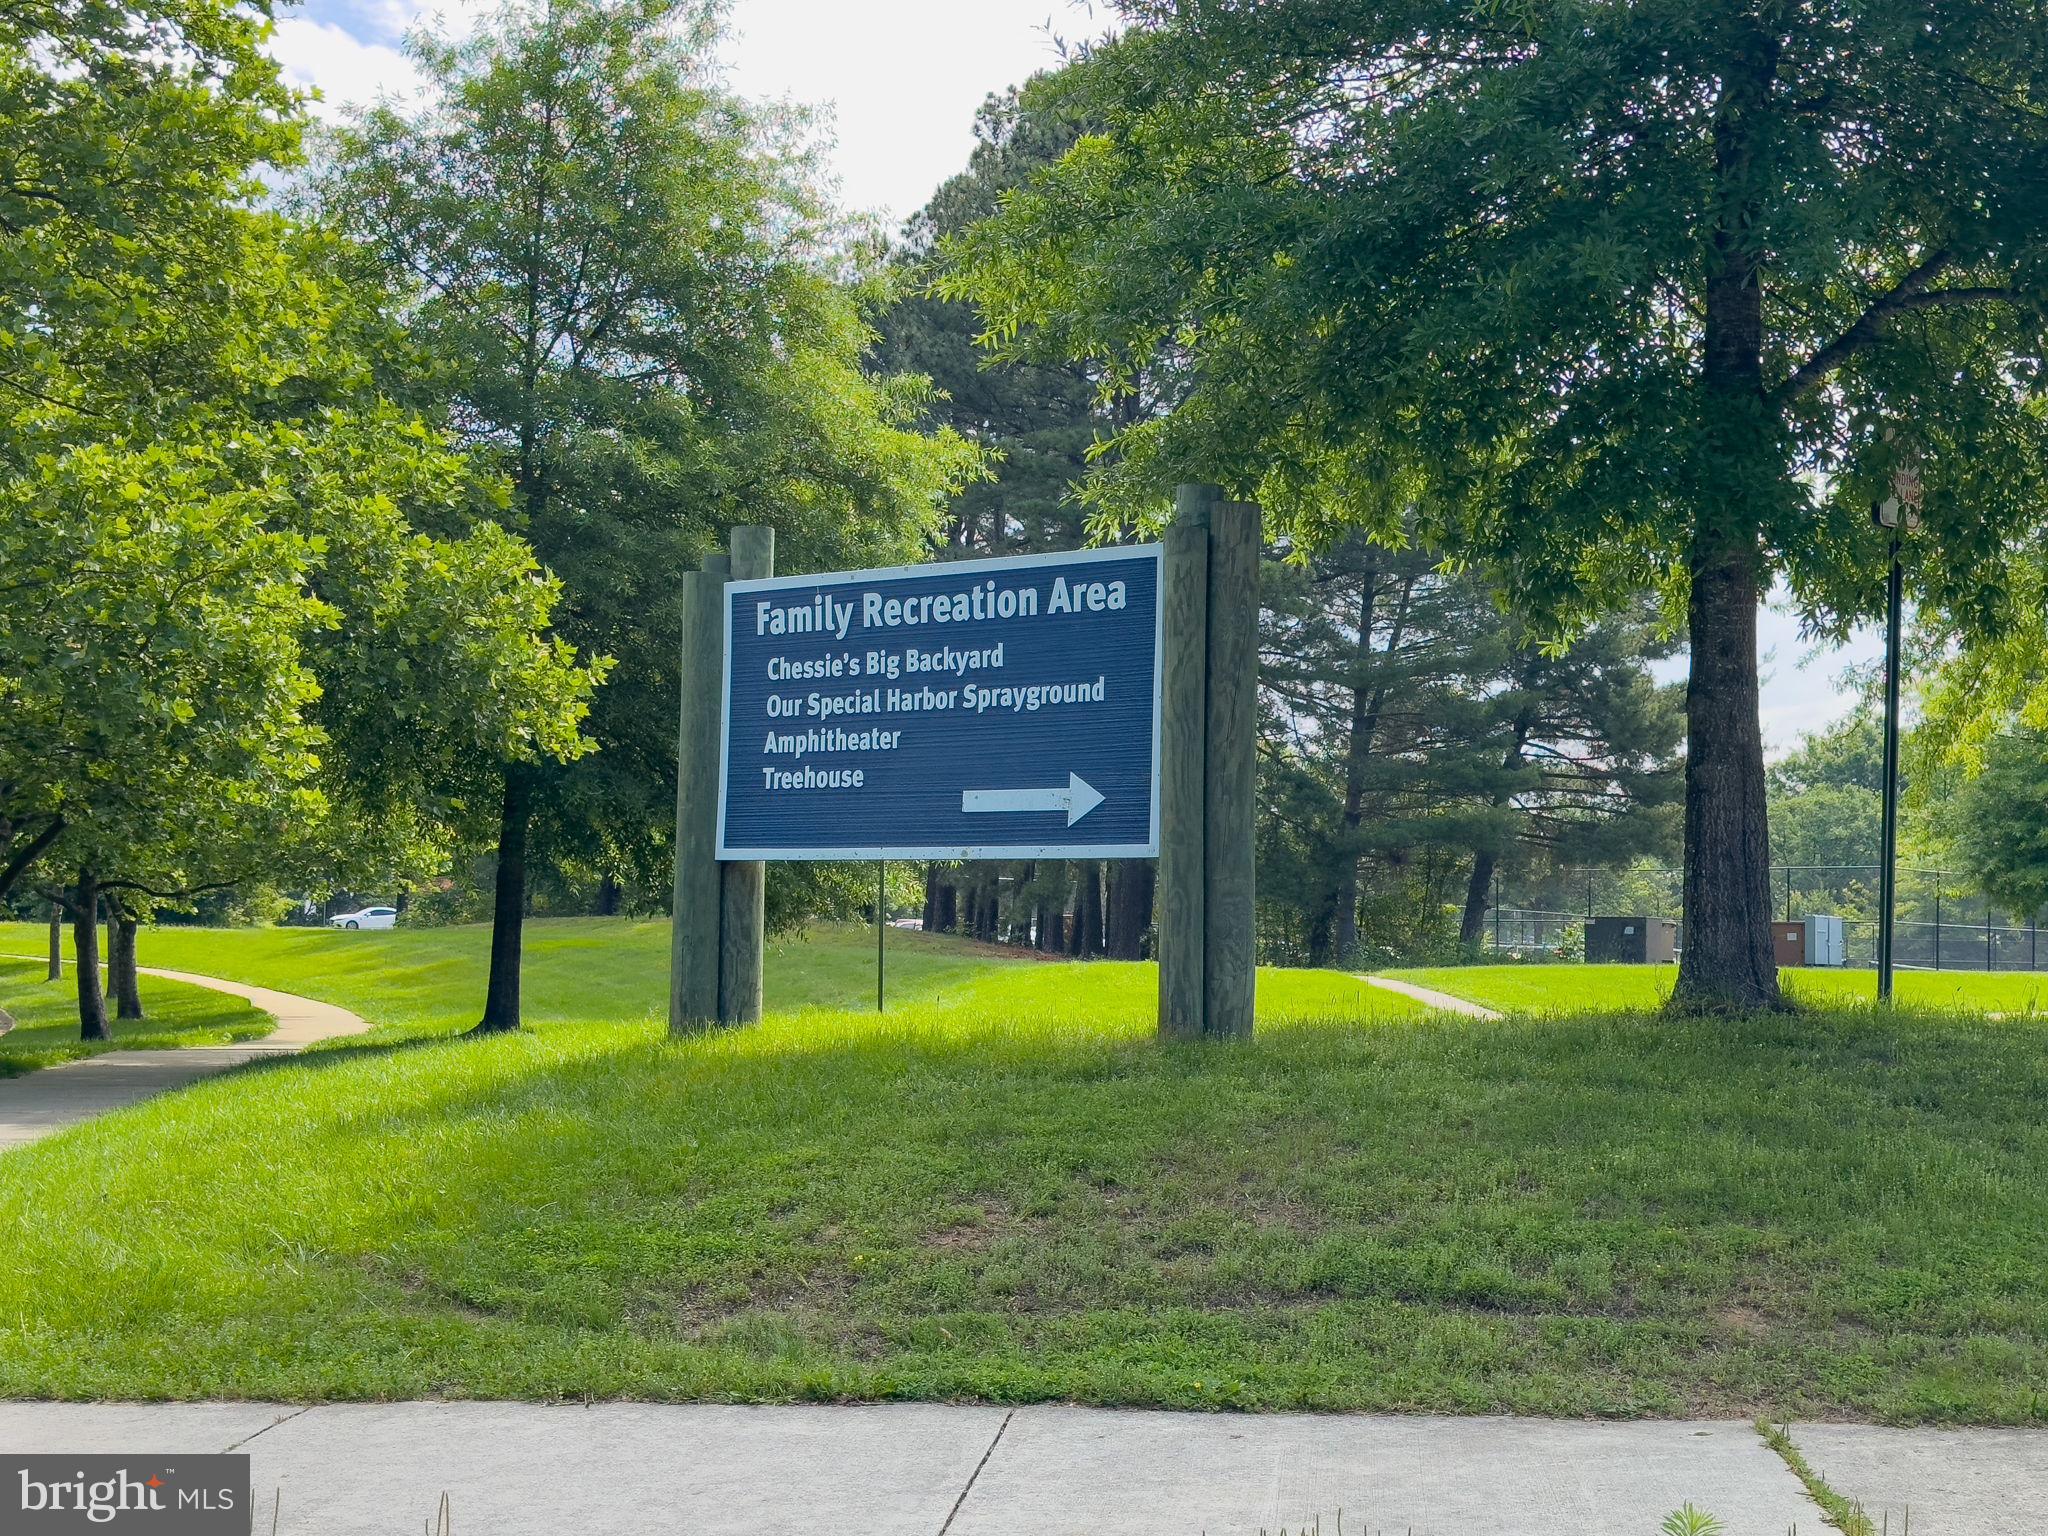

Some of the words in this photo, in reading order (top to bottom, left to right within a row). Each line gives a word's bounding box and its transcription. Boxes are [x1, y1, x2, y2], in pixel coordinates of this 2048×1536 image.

[757, 593, 854, 640] Family
[863, 580, 1038, 628] Recreation
[1047, 577, 1127, 615] Area
[767, 652, 861, 681] Chessie's
[867, 649, 900, 680] Big
[906, 642, 1005, 677] Backyard
[766, 693, 803, 719] Our
[807, 688, 881, 721] Special
[887, 685, 958, 713] Harbor
[963, 675, 1106, 714] Sprayground
[763, 727, 902, 760] Amphitheater
[762, 765, 865, 791] Treehouse
